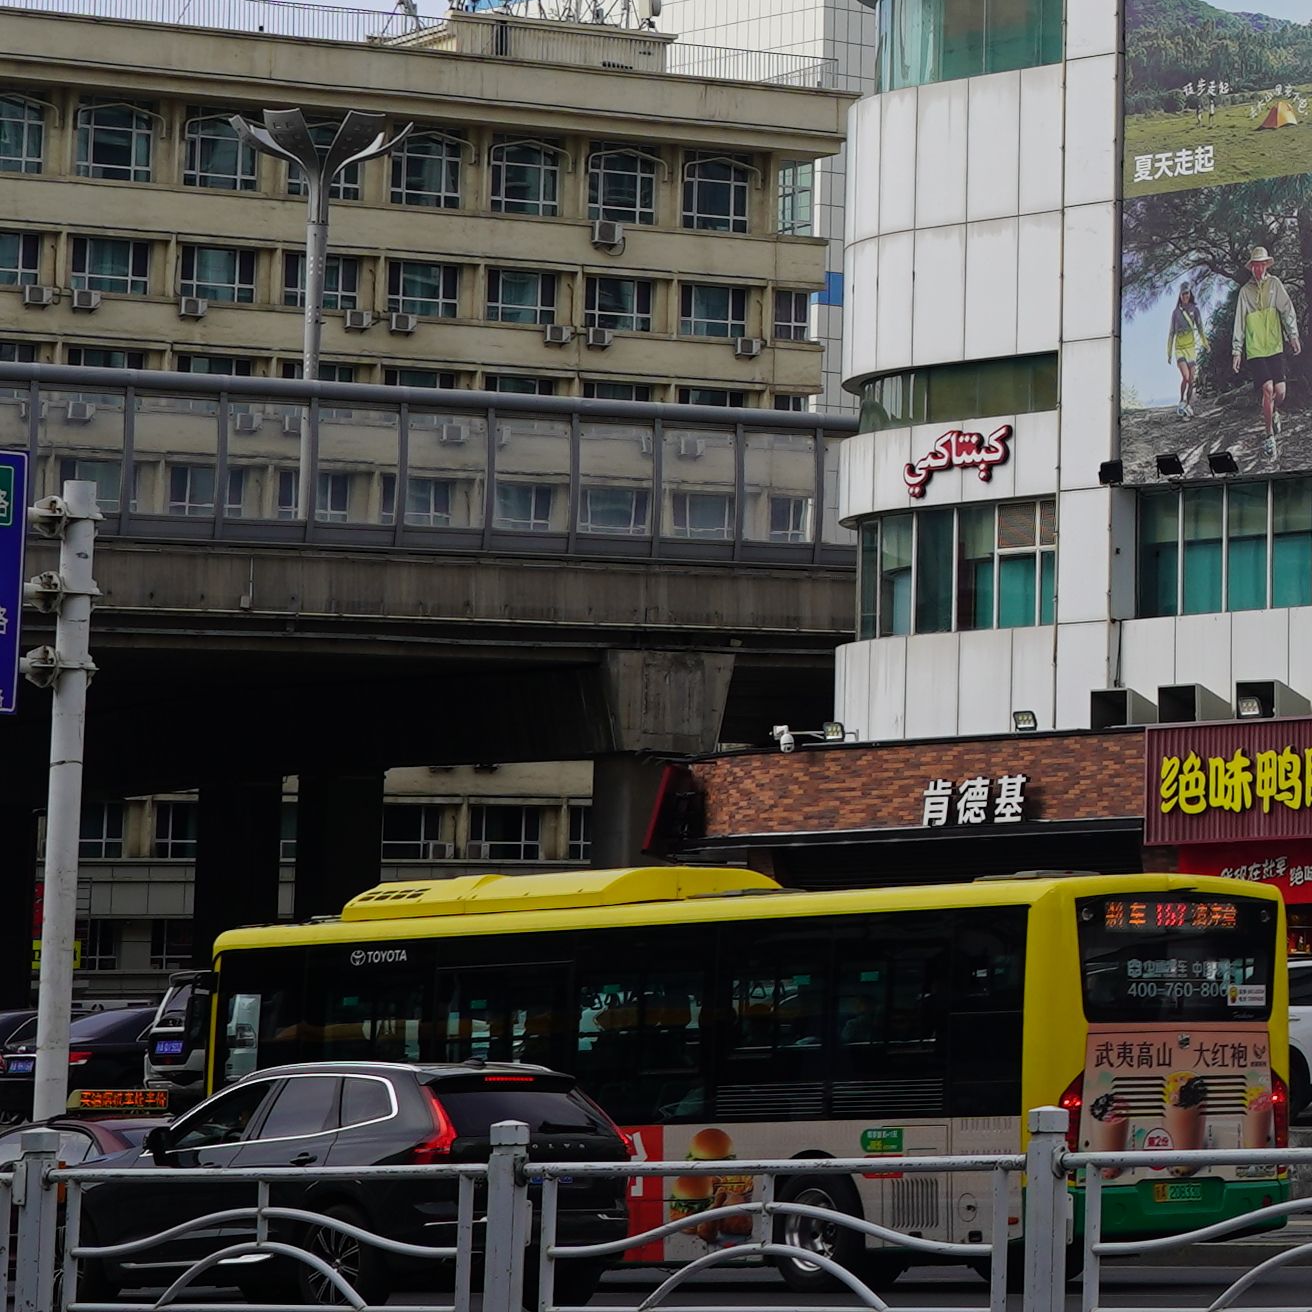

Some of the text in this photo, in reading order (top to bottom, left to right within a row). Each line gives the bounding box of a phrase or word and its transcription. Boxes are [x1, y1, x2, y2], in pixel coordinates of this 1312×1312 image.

[1133, 145, 1214, 183] 夏天走起
[922, 774, 1028, 827] 肯德基
[367, 949, 408, 963] TOYOTA
[1094, 1041, 1248, 1068] 武夷高山 大红袍
